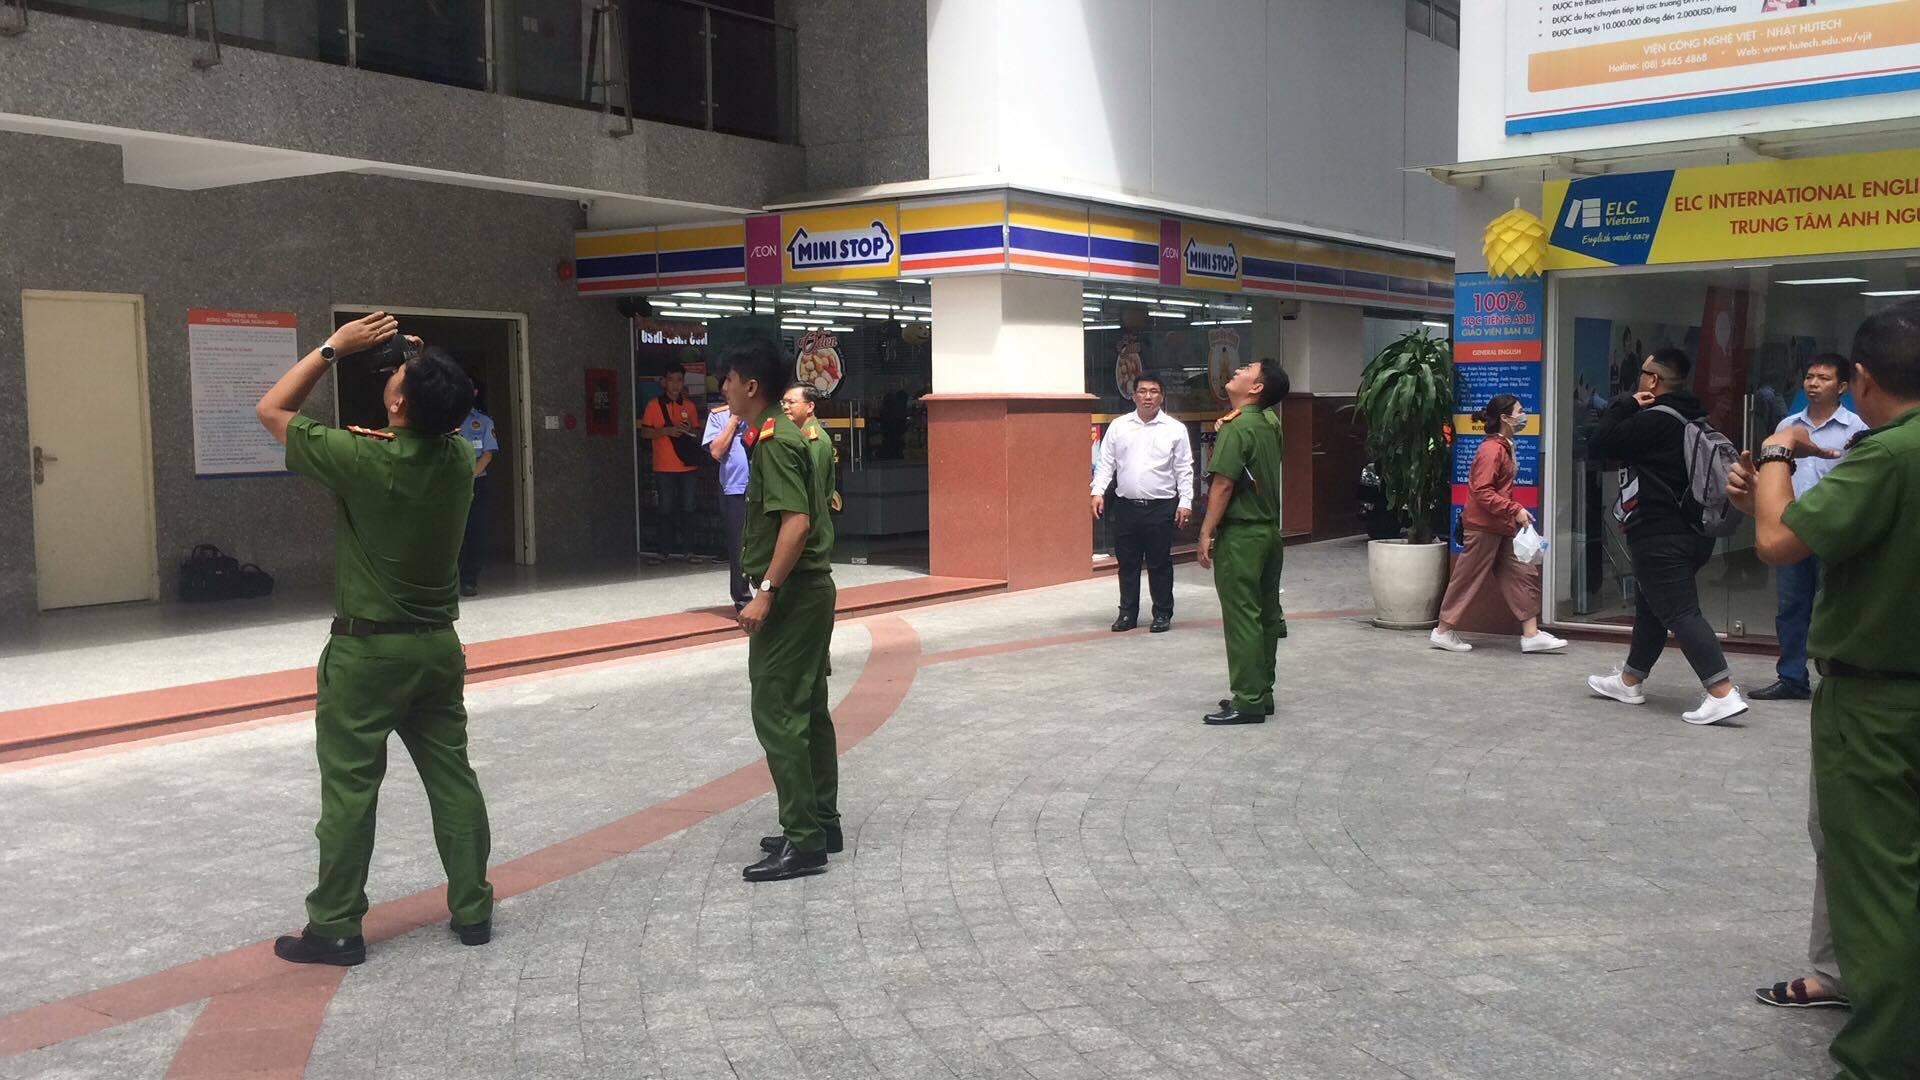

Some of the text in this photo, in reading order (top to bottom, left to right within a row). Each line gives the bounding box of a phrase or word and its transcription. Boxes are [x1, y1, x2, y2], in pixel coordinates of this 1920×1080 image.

[1603, 18, 1641, 30] 10.000.000
[1799, 18, 1843, 34] HUTECH
[1608, 62, 1639, 74] Hotline:
[1736, 45, 1760, 57] Web:
[1762, 31, 1873, 54] www.hutech.edu.vn/vjit
[1606, 200, 1638, 216] ELC
[1675, 195, 1703, 212] ELC
[1708, 183, 1857, 209] INTERNATIONAL
[1605, 215, 1650, 226] Vietnam
[1730, 207, 1920, 235] TRUNG TÂM ANH NG
[798, 236, 884, 262] MINI STOP
[1582, 231, 1611, 247] English
[1189, 251, 1235, 272] MINI STOP
[1473, 291, 1527, 312] 100%
